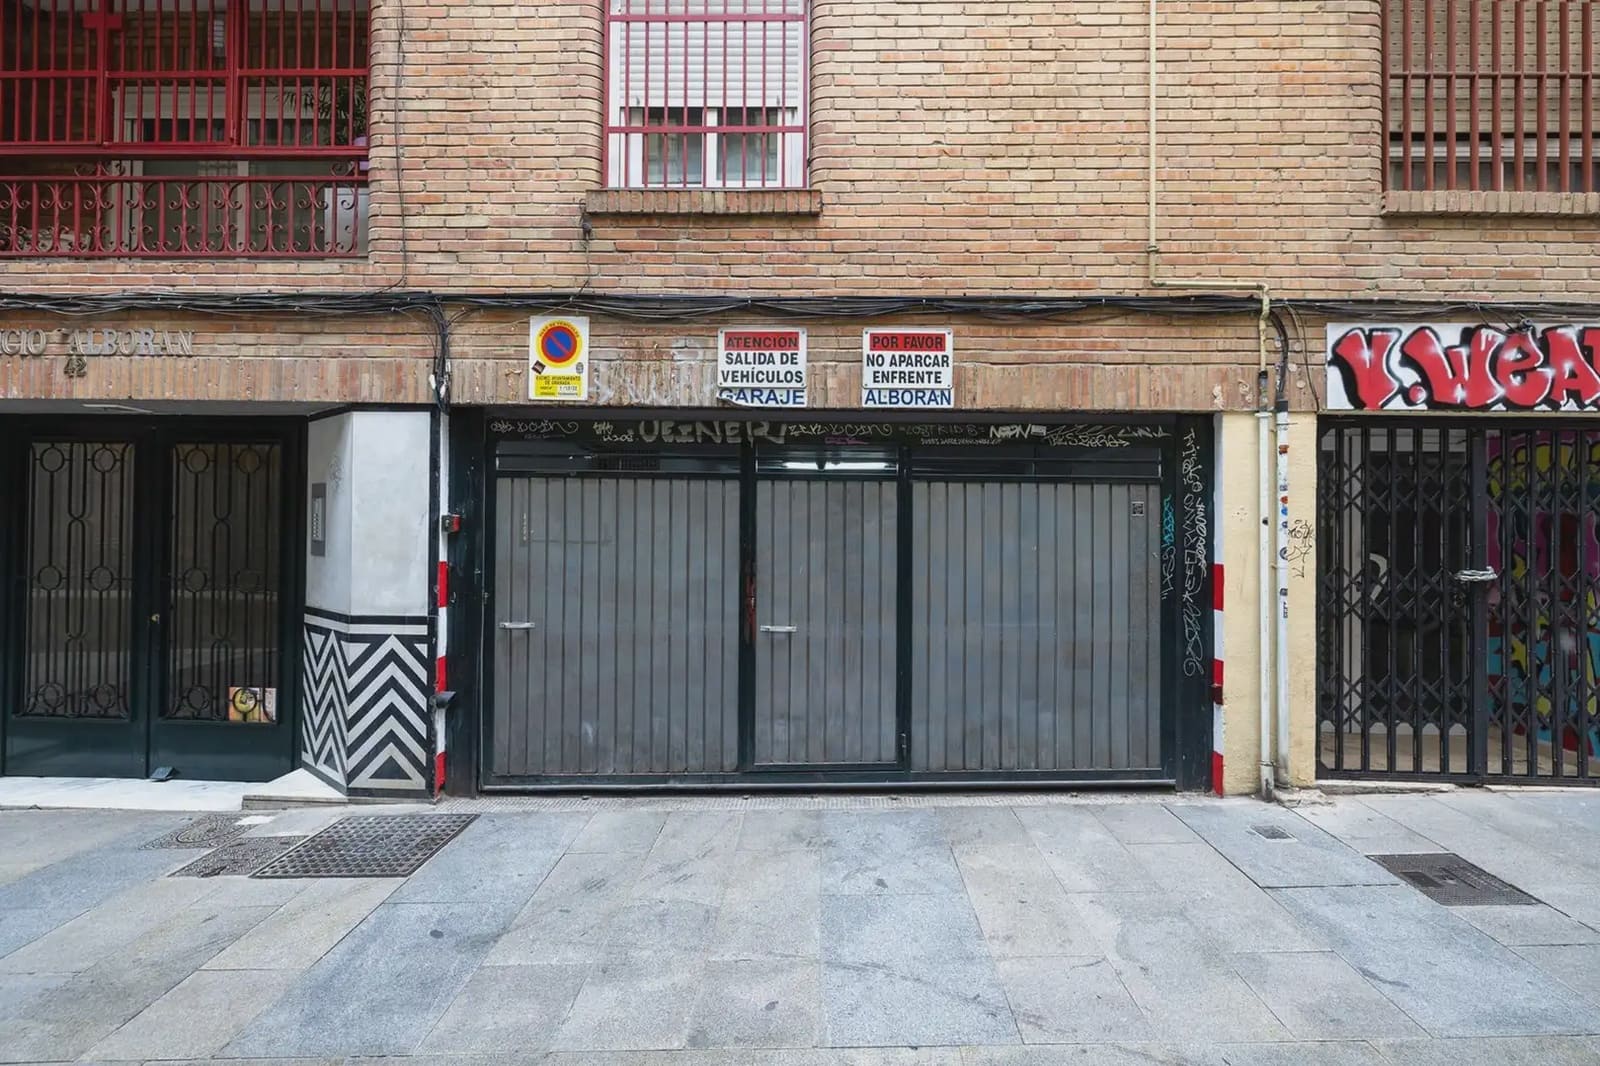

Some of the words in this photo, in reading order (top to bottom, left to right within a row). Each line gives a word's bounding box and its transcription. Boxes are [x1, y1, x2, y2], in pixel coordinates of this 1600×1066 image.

[68, 328, 194, 356] ALBORAN
[725, 337, 799, 349] ATENCION
[872, 336, 898, 348] POR
[903, 336, 943, 348] FAVOR
[725, 352, 776, 366] SALIDA
[781, 352, 798, 365] DE
[866, 354, 885, 368] NO
[889, 354, 949, 368] APARCAR
[64, 357, 87, 378] 42
[721, 367, 804, 384] VEHÍCULOS
[873, 370, 942, 384] ENFRENTE
[718, 388, 805, 405] GARAJE
[864, 388, 952, 405] ALBORAN
